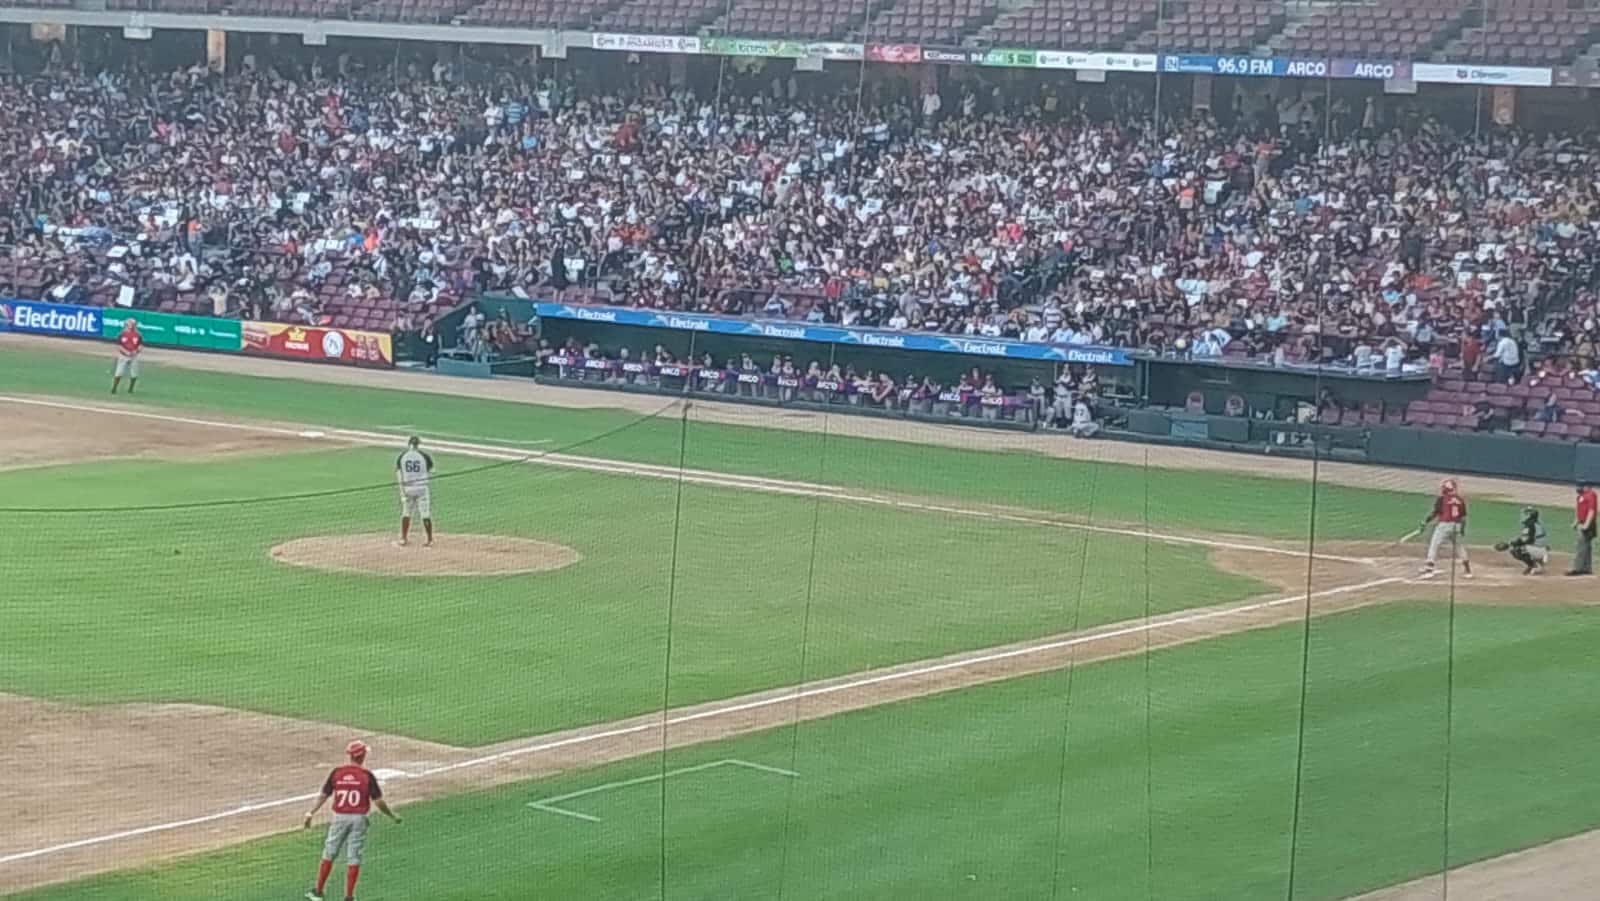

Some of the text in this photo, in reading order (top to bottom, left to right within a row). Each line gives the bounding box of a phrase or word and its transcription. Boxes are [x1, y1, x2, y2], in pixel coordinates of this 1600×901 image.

[1217, 57, 1248, 74] 96.9
[1250, 59, 1273, 75] FM
[1286, 61, 1326, 76] ARCO
[1353, 62, 1394, 78] ARCO
[14, 305, 99, 332] Electrolit
[405, 459, 421, 473] 66
[335, 789, 361, 808] 70
